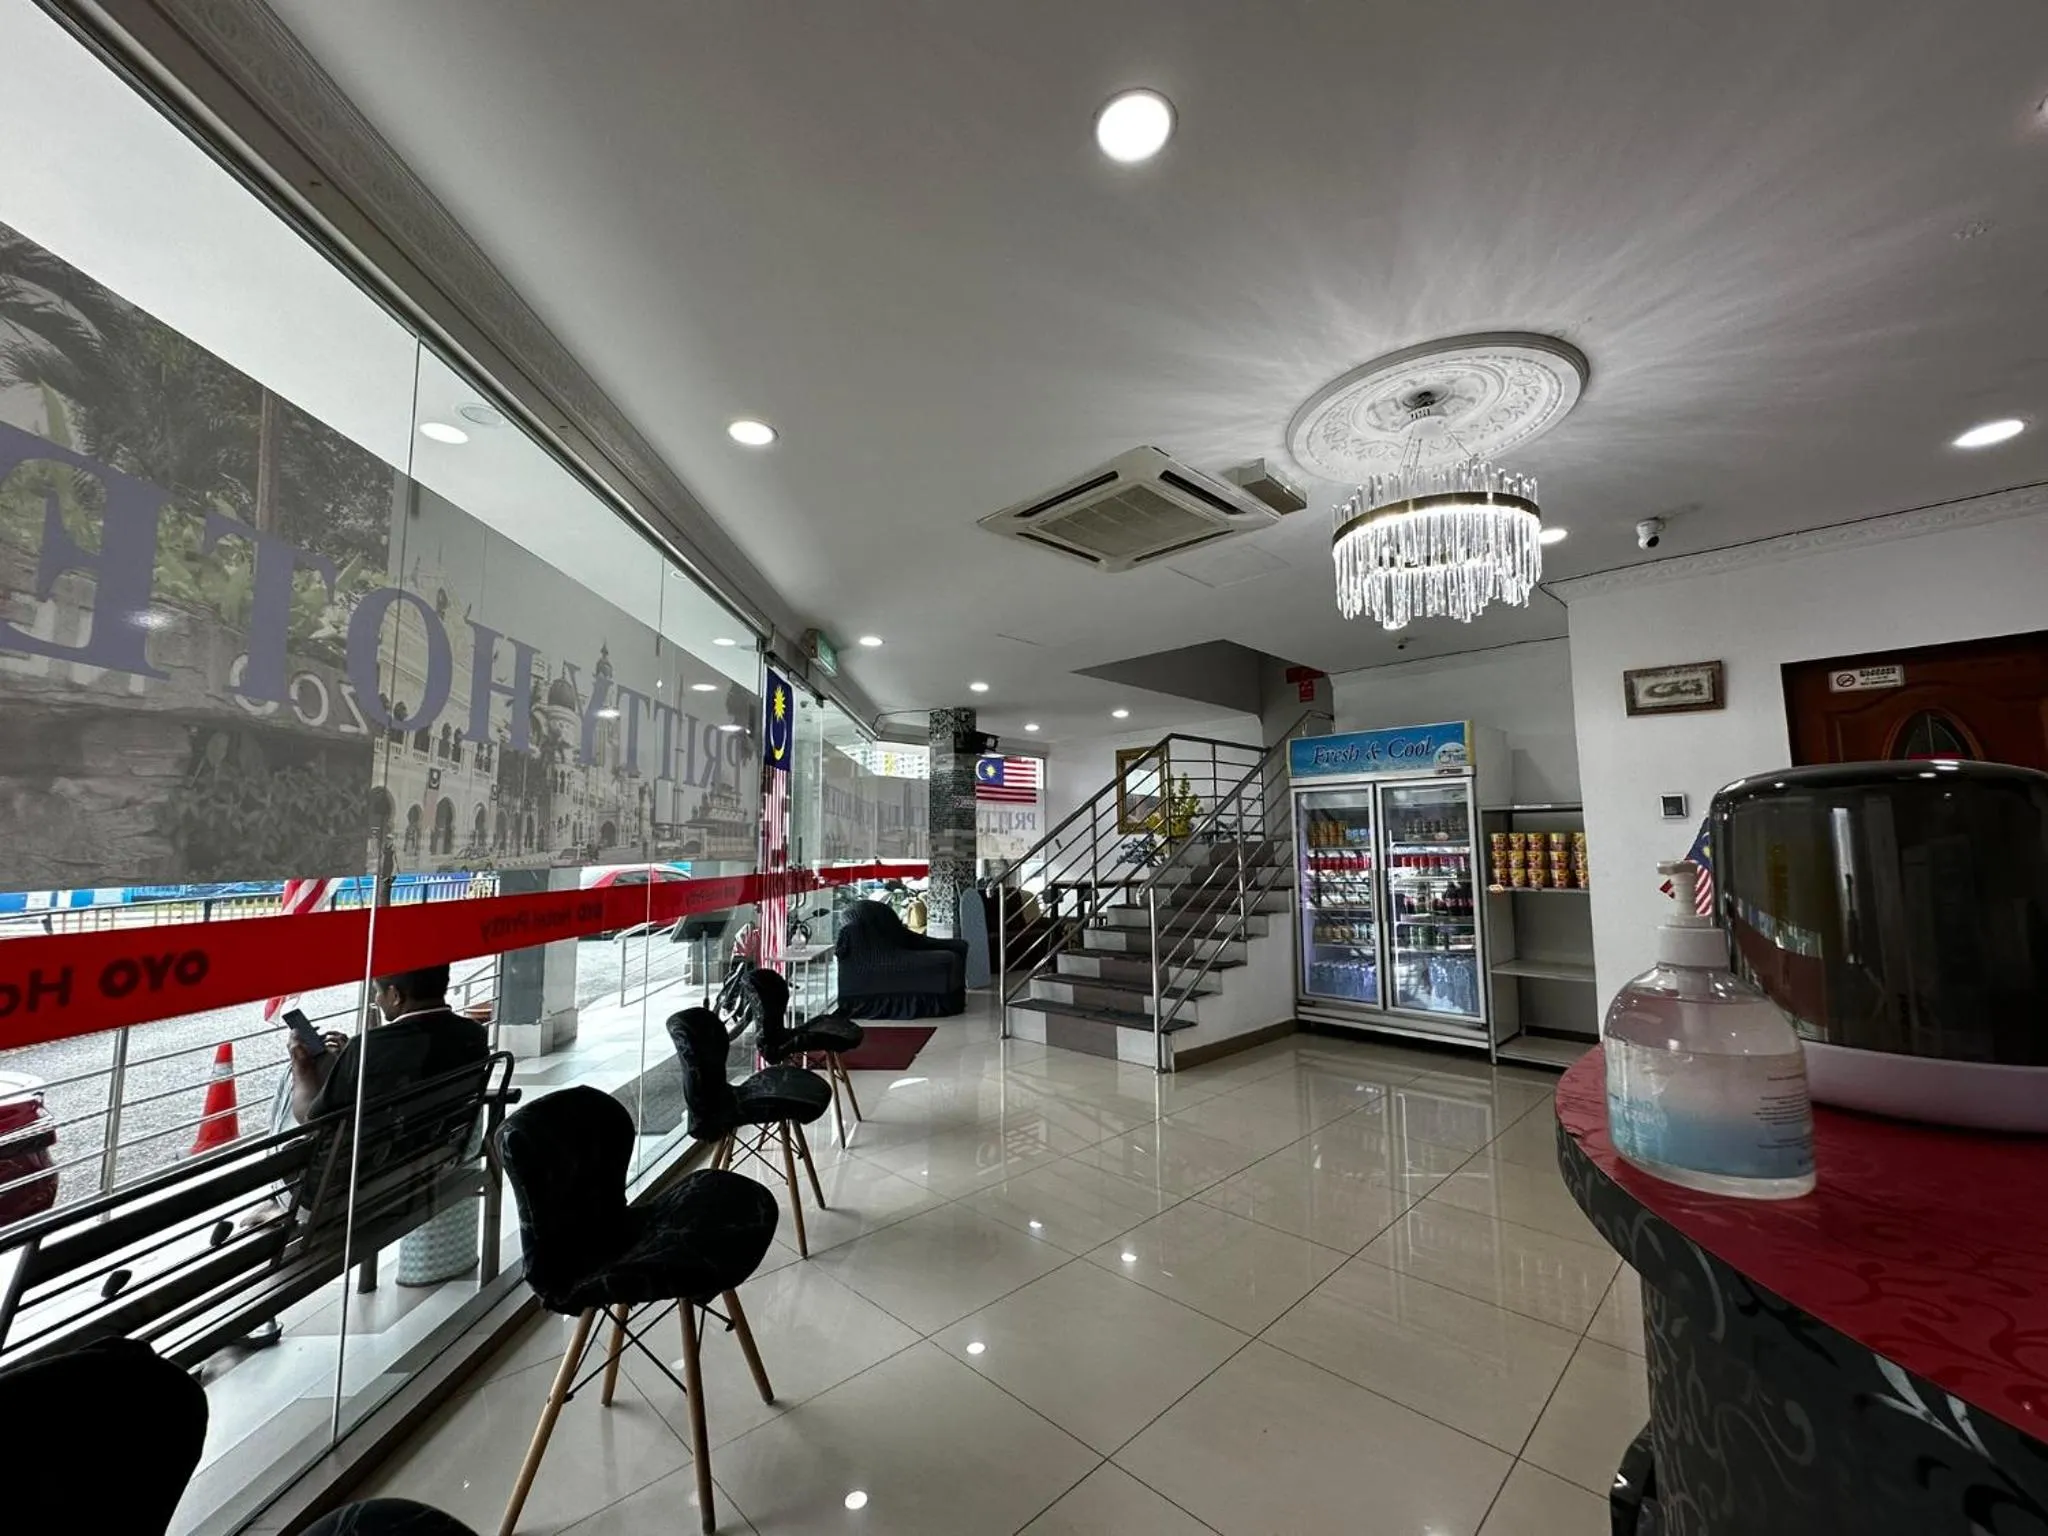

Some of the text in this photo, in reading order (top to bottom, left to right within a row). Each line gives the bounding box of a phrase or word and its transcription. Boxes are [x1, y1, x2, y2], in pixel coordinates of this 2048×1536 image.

[1313, 743, 1360, 764] Fresh
[1366, 741, 1381, 760] &
[1388, 736, 1432, 760] Cool
